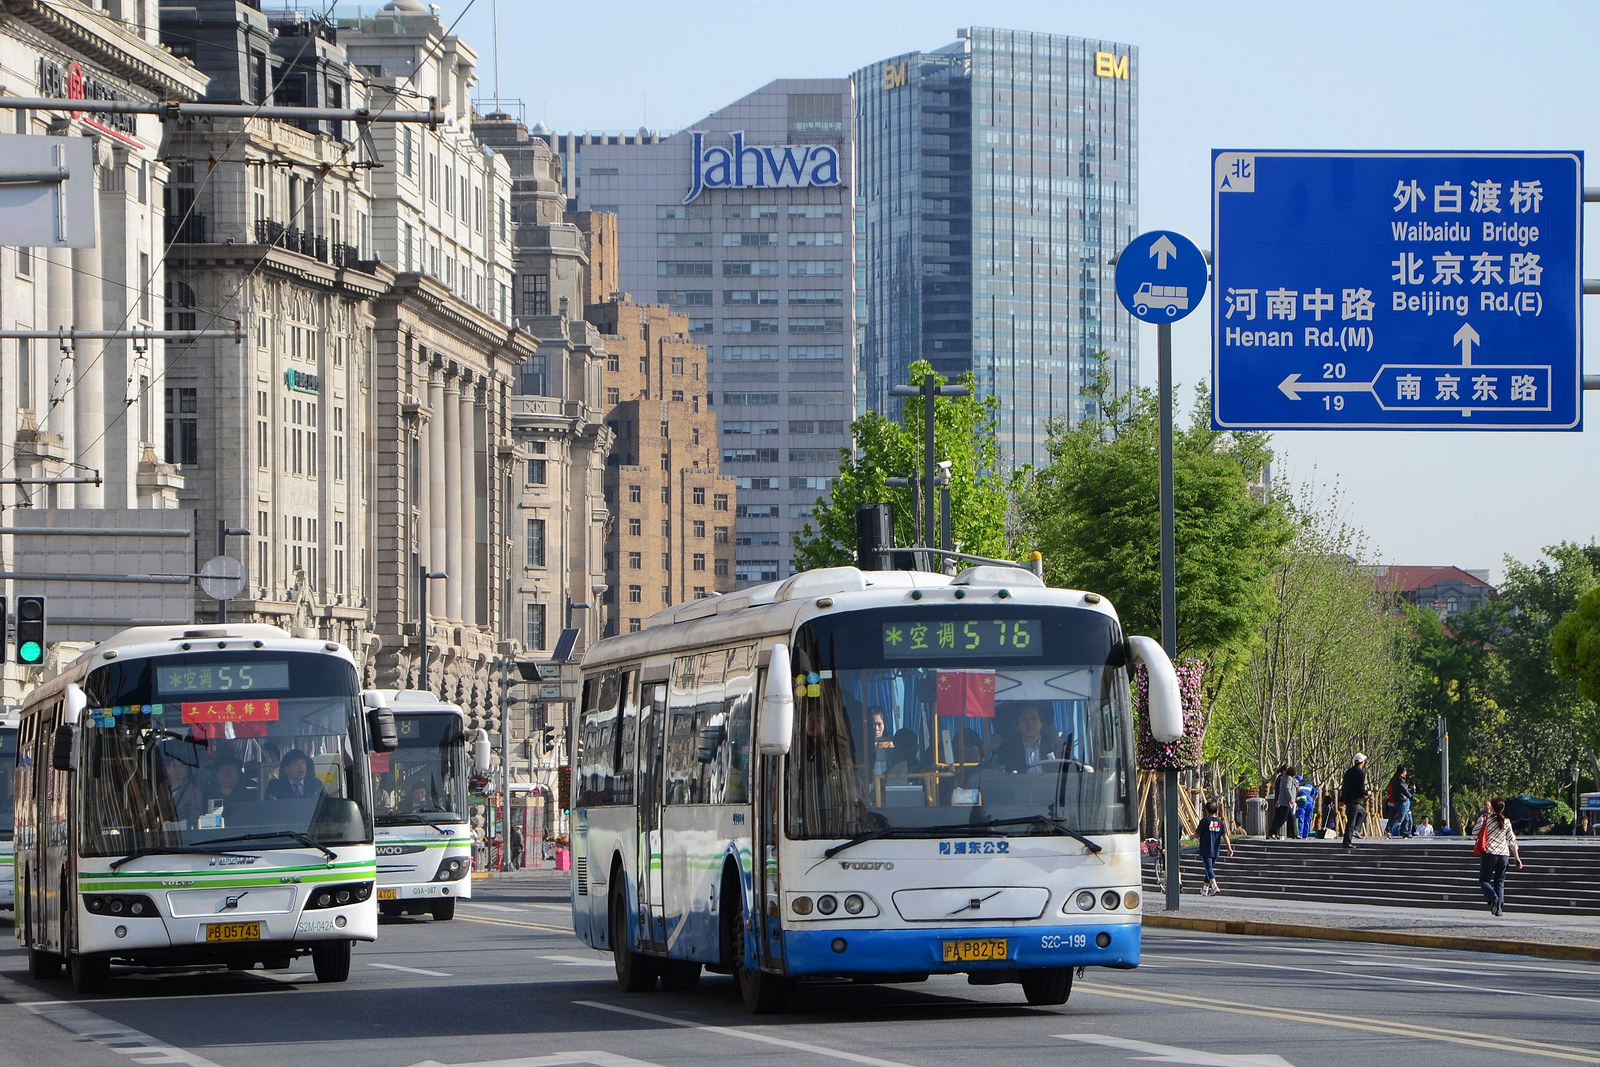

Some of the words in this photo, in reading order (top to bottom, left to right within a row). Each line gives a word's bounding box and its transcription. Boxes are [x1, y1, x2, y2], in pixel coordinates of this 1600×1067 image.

[683, 131, 841, 204] Jahwa
[1232, 158, 1251, 178] 北
[1393, 179, 1544, 213] 外白渡桥
[1391, 221, 1471, 241] Waibaidu
[1482, 221, 1540, 247] Bridge
[1391, 250, 1544, 285] 北京东路
[1224, 287, 1376, 321] 河南中路
[1392, 291, 1469, 316] Beijing
[1480, 291, 1543, 316] Rd.(E)
[1225, 327, 1294, 347] Henan
[1304, 327, 1374, 352] Rd.(M)
[1322, 363, 1347, 379] 20
[1396, 373, 1537, 401] 南京东路
[1322, 395, 1345, 411] 19
[909, 622, 956, 649] 空调
[964, 620, 1031, 649] 576
[218, 665, 253, 690] 55
[954, 841, 1010, 855] 浦东公交
[840, 861, 894, 871] VOLVO
[299, 921, 335, 932] S2M-042A
[1041, 935, 1086, 949] S2C-199
